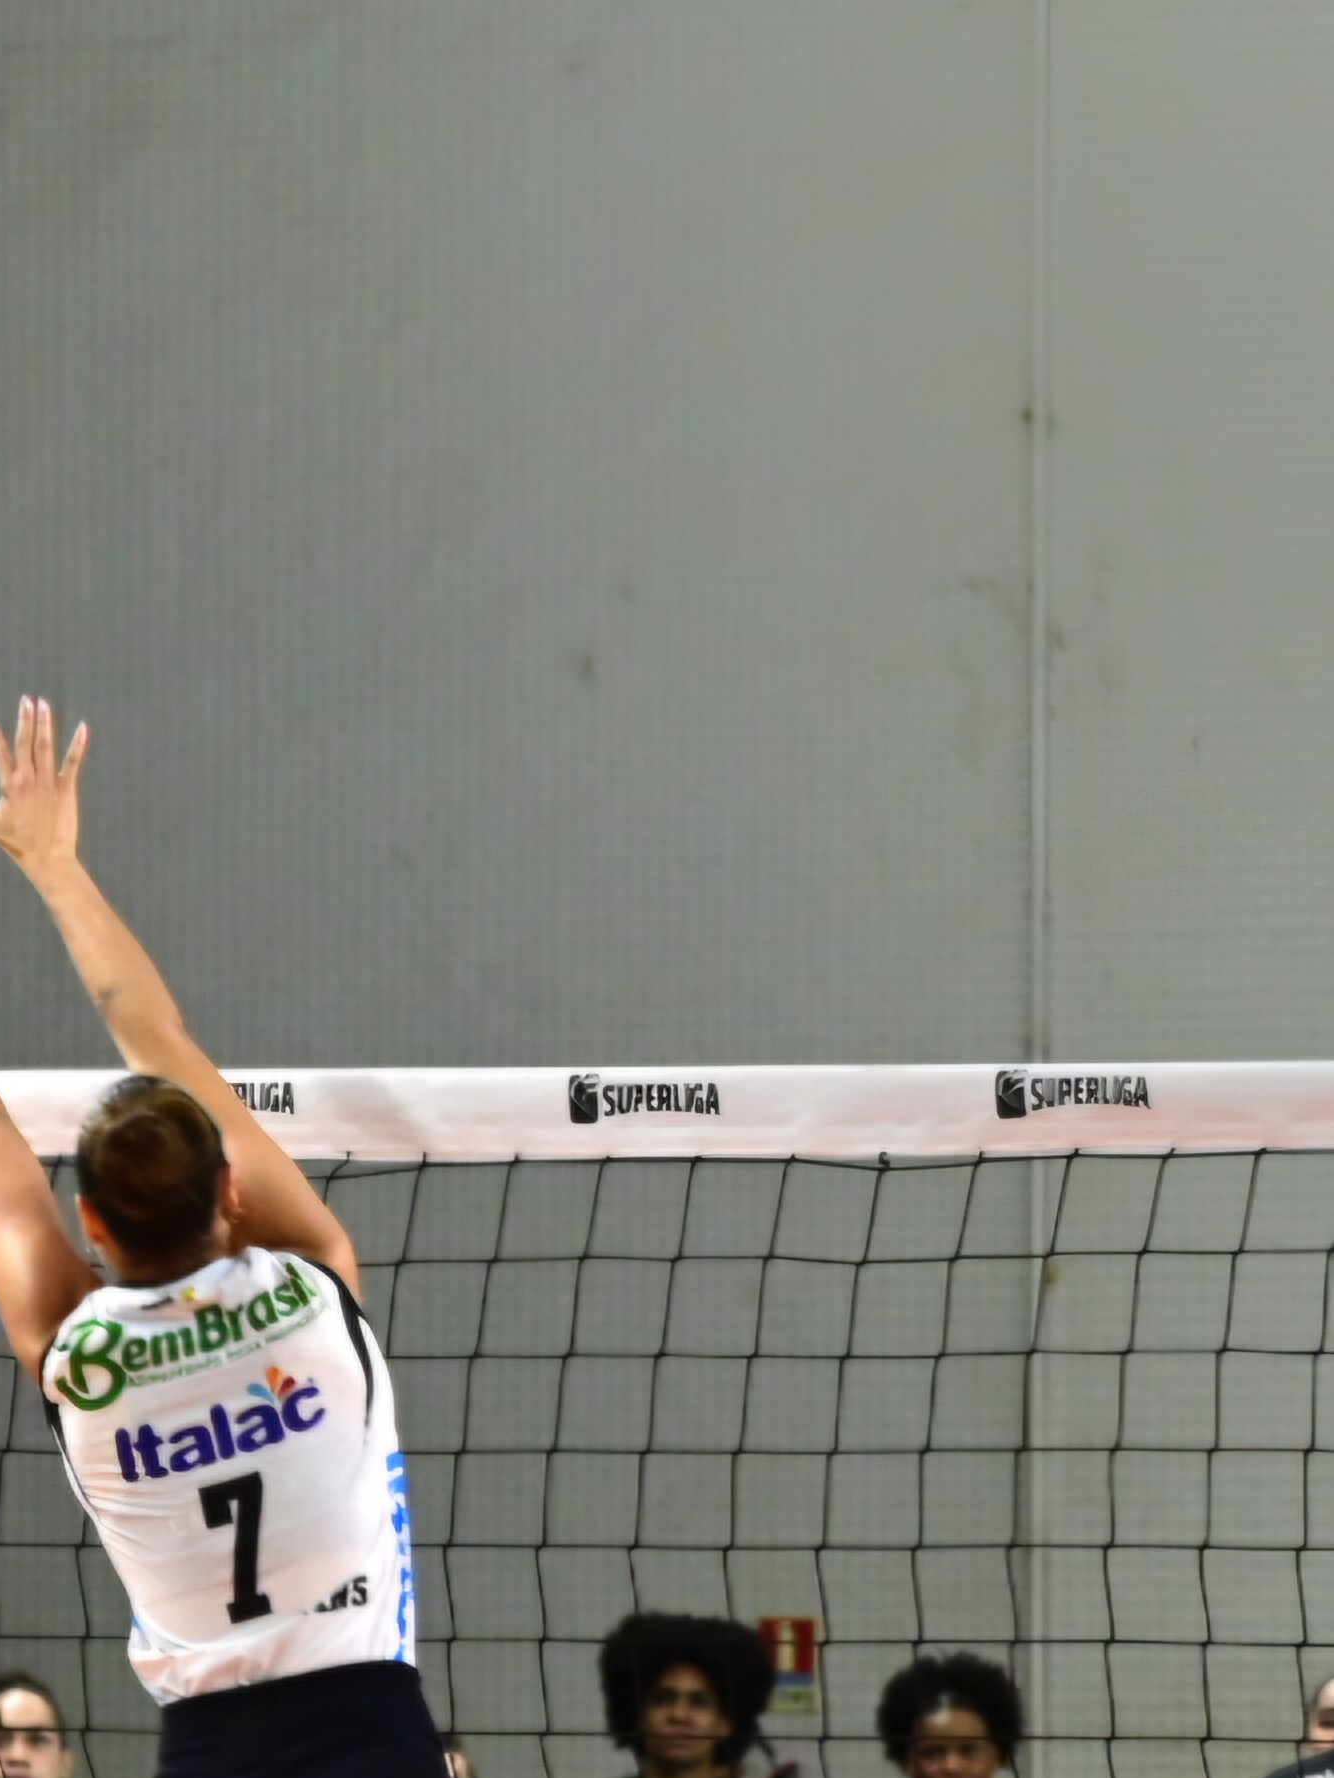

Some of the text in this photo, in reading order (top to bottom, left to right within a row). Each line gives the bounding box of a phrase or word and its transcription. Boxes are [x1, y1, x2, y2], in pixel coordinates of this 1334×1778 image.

[602, 1083, 721, 1117] SUPERLIGA
[1031, 1076, 1152, 1111] SUPERLIGA
[115, 1386, 326, 1482] Italac
[198, 1471, 273, 1624] 7
